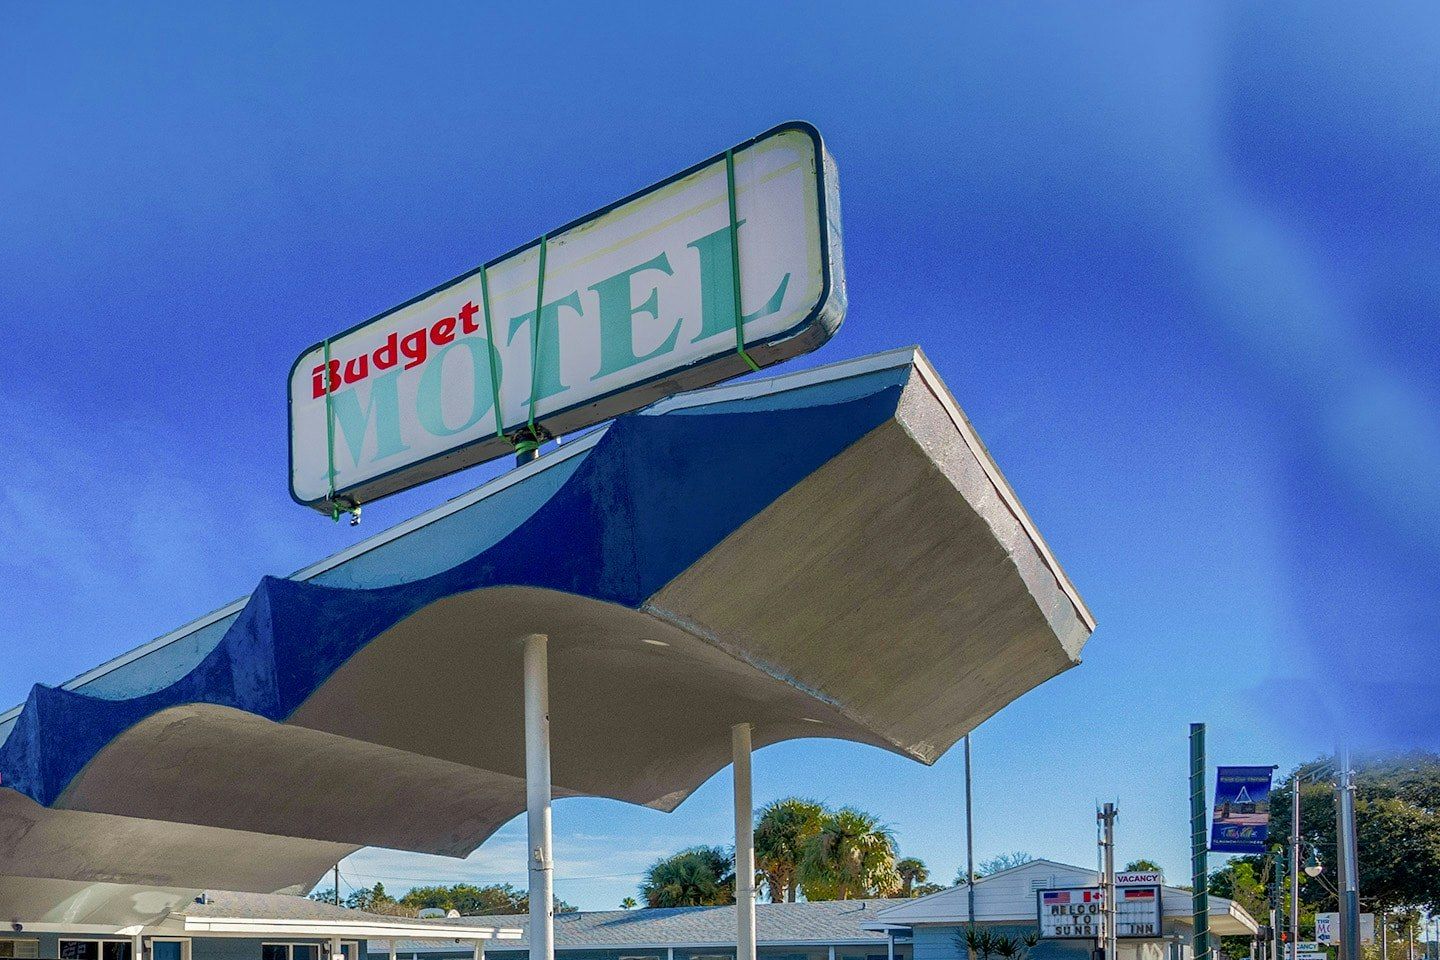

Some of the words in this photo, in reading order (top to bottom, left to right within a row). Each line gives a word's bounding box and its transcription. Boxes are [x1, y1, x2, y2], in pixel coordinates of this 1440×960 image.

[312, 301, 479, 399] Budget
[321, 218, 792, 480] MOTEL
[1117, 874, 1158, 883] VACANCY
[1073, 915, 1092, 924] TO
[1130, 924, 1153, 934] INN
